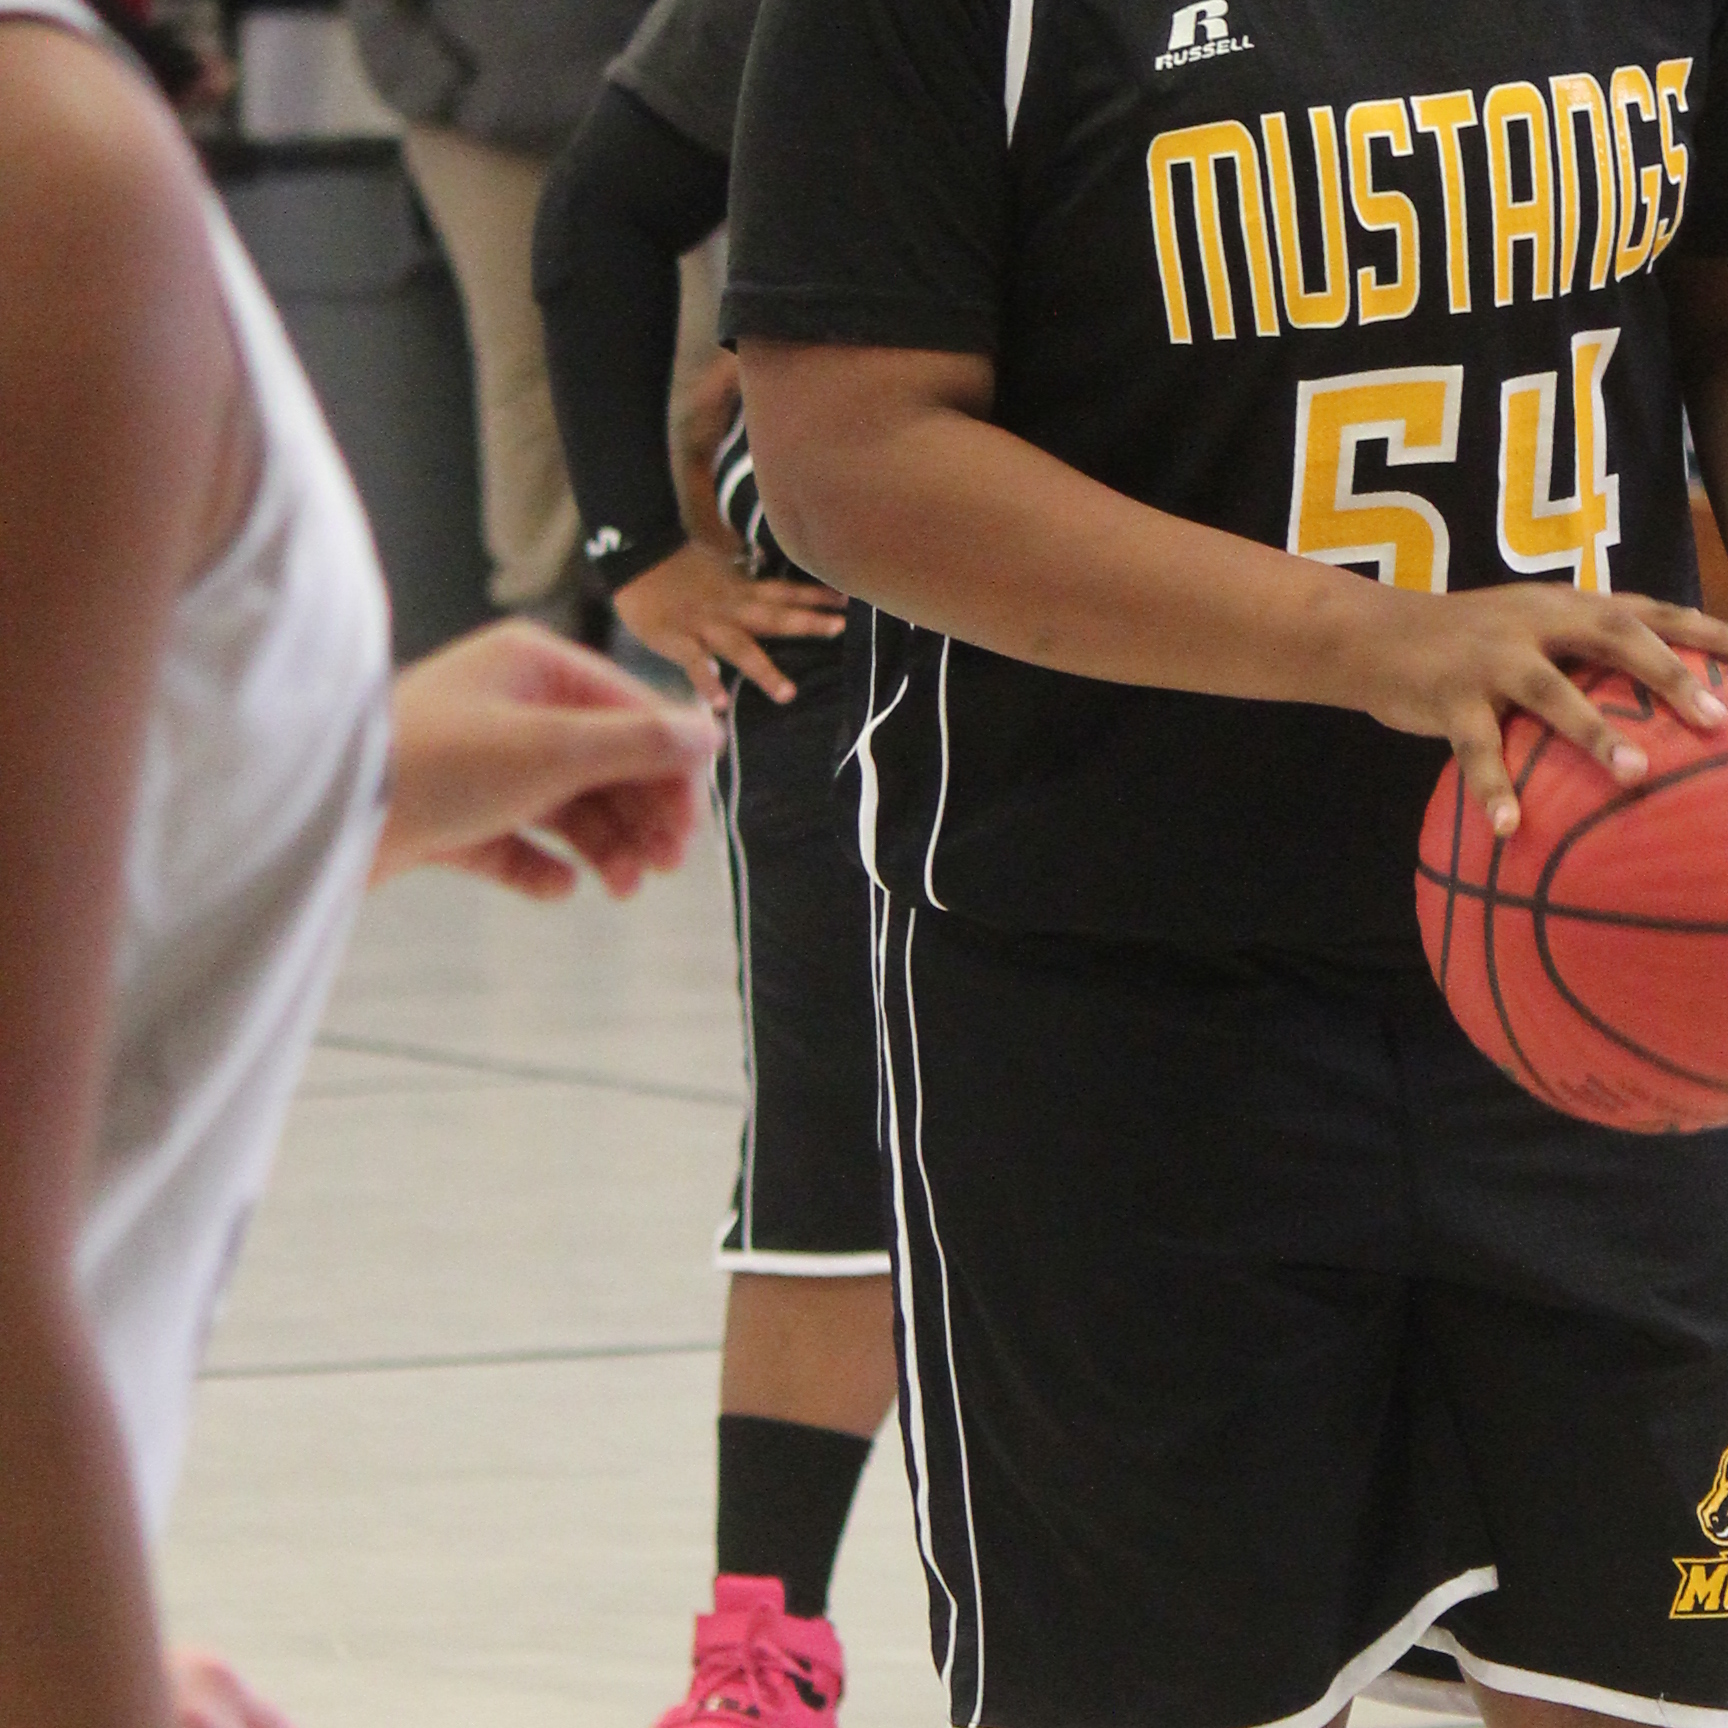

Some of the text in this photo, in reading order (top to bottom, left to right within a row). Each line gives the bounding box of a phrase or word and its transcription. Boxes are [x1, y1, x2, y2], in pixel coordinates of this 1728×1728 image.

[1155, 35, 1255, 71] RUSSELL
[1146, 57, 1694, 345] MUSTANGS
[1287, 327, 1622, 596] 54
